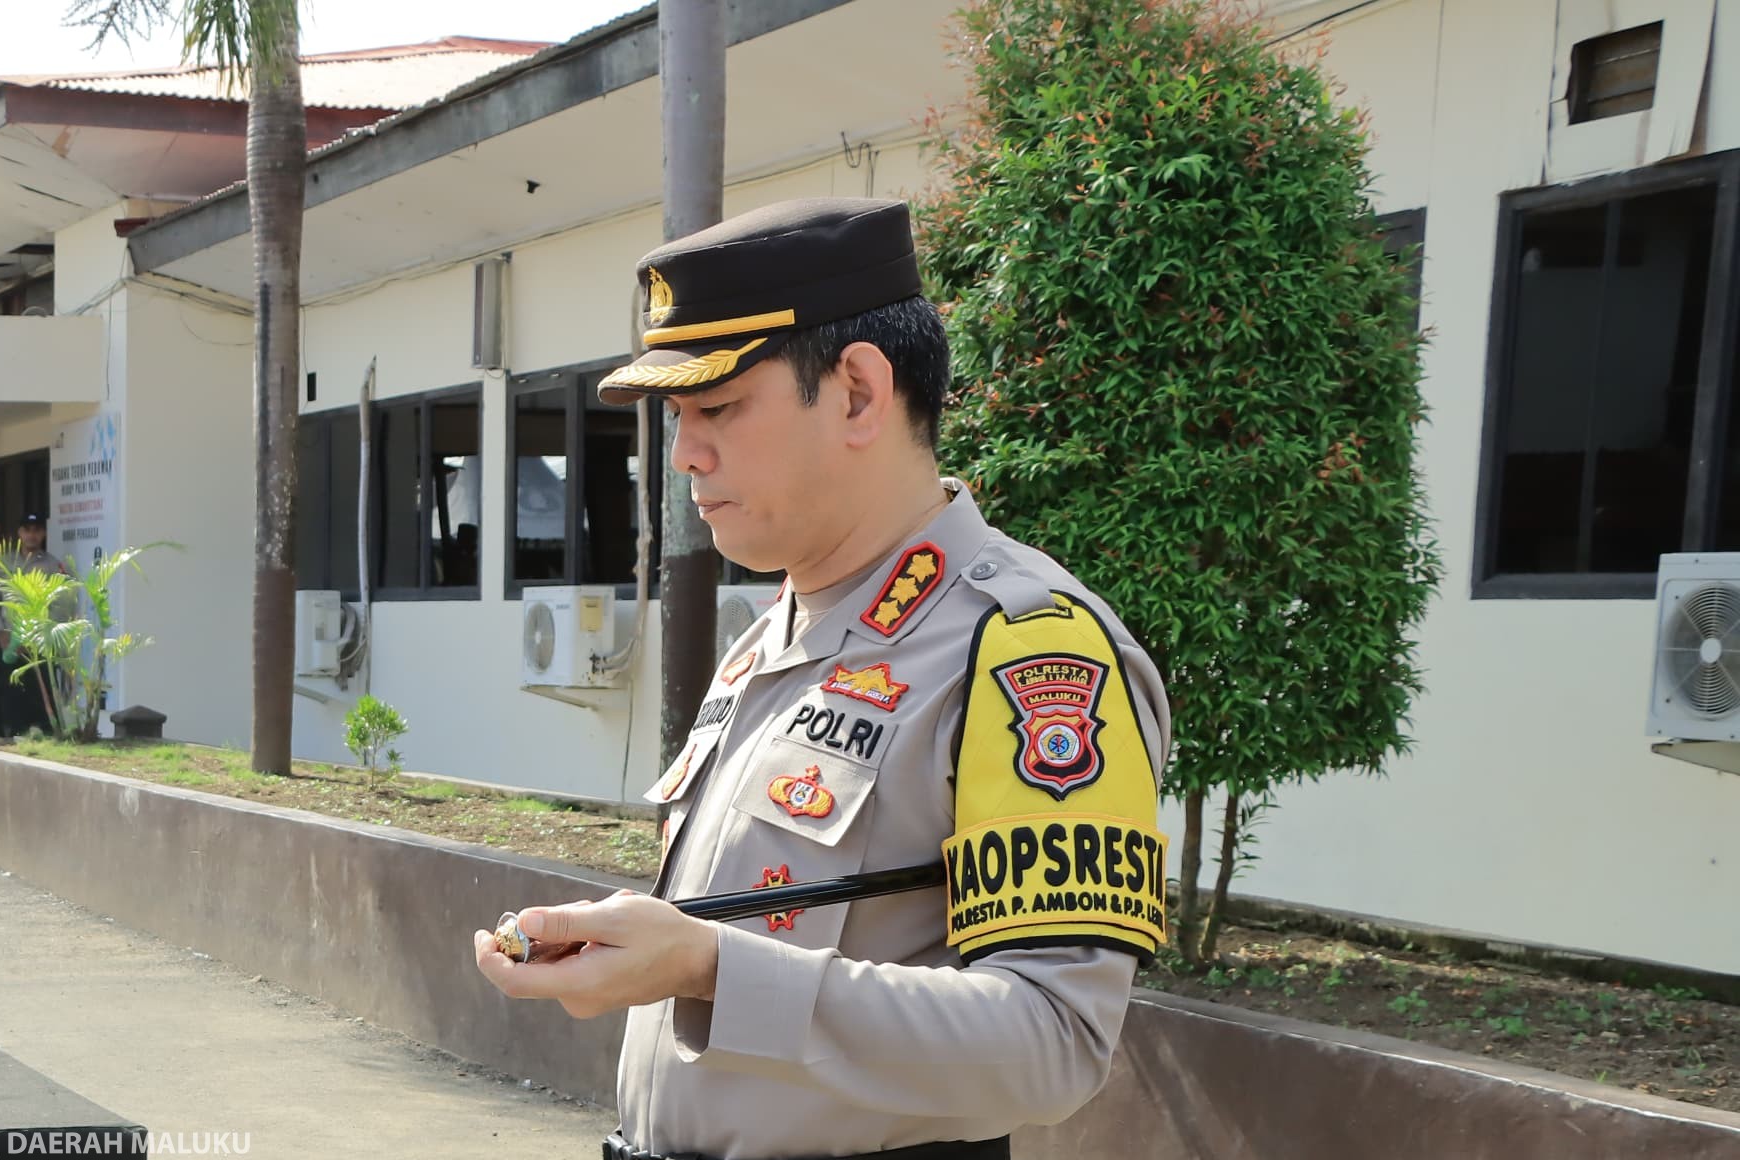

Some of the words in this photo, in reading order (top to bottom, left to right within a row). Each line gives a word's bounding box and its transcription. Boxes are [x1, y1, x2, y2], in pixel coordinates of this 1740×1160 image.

[1013, 664, 1088, 681] POLRESTA
[1028, 692, 1081, 704] MALUKU
[786, 703, 884, 760] POLRI
[951, 899, 1008, 935] POLRESTA
[1011, 895, 1028, 915] P.
[1032, 891, 1108, 912] AMBON
[1110, 893, 1123, 914] &
